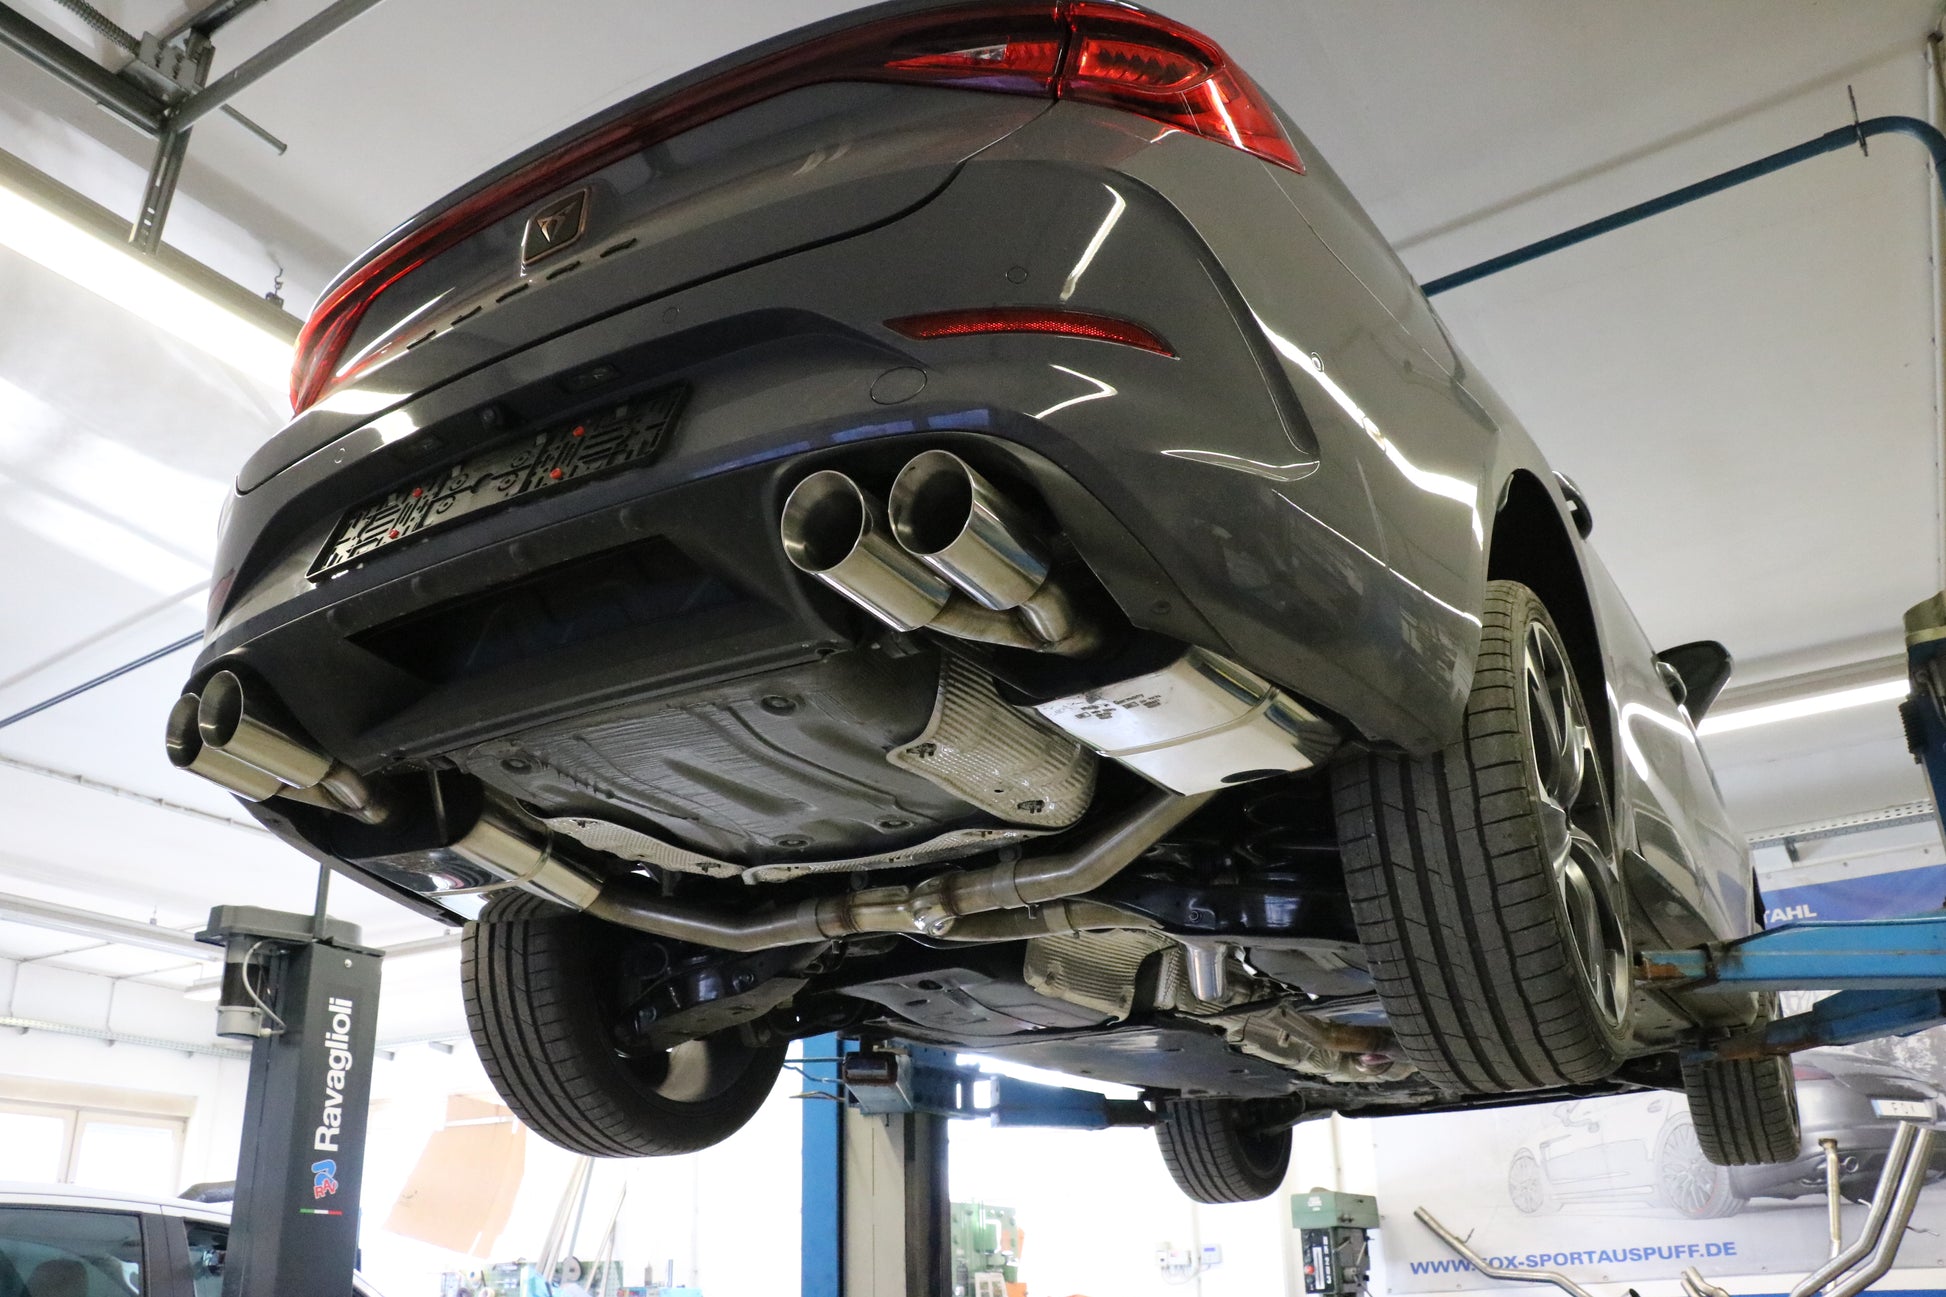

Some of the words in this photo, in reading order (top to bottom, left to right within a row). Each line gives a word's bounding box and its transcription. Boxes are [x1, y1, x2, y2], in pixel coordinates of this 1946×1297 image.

[314, 997, 353, 1151] Ravaglioli
[313, 1178, 338, 1199] RAV
[1410, 1241, 1738, 1275] WWW.OX-SPORTAUSPUFF.DE
